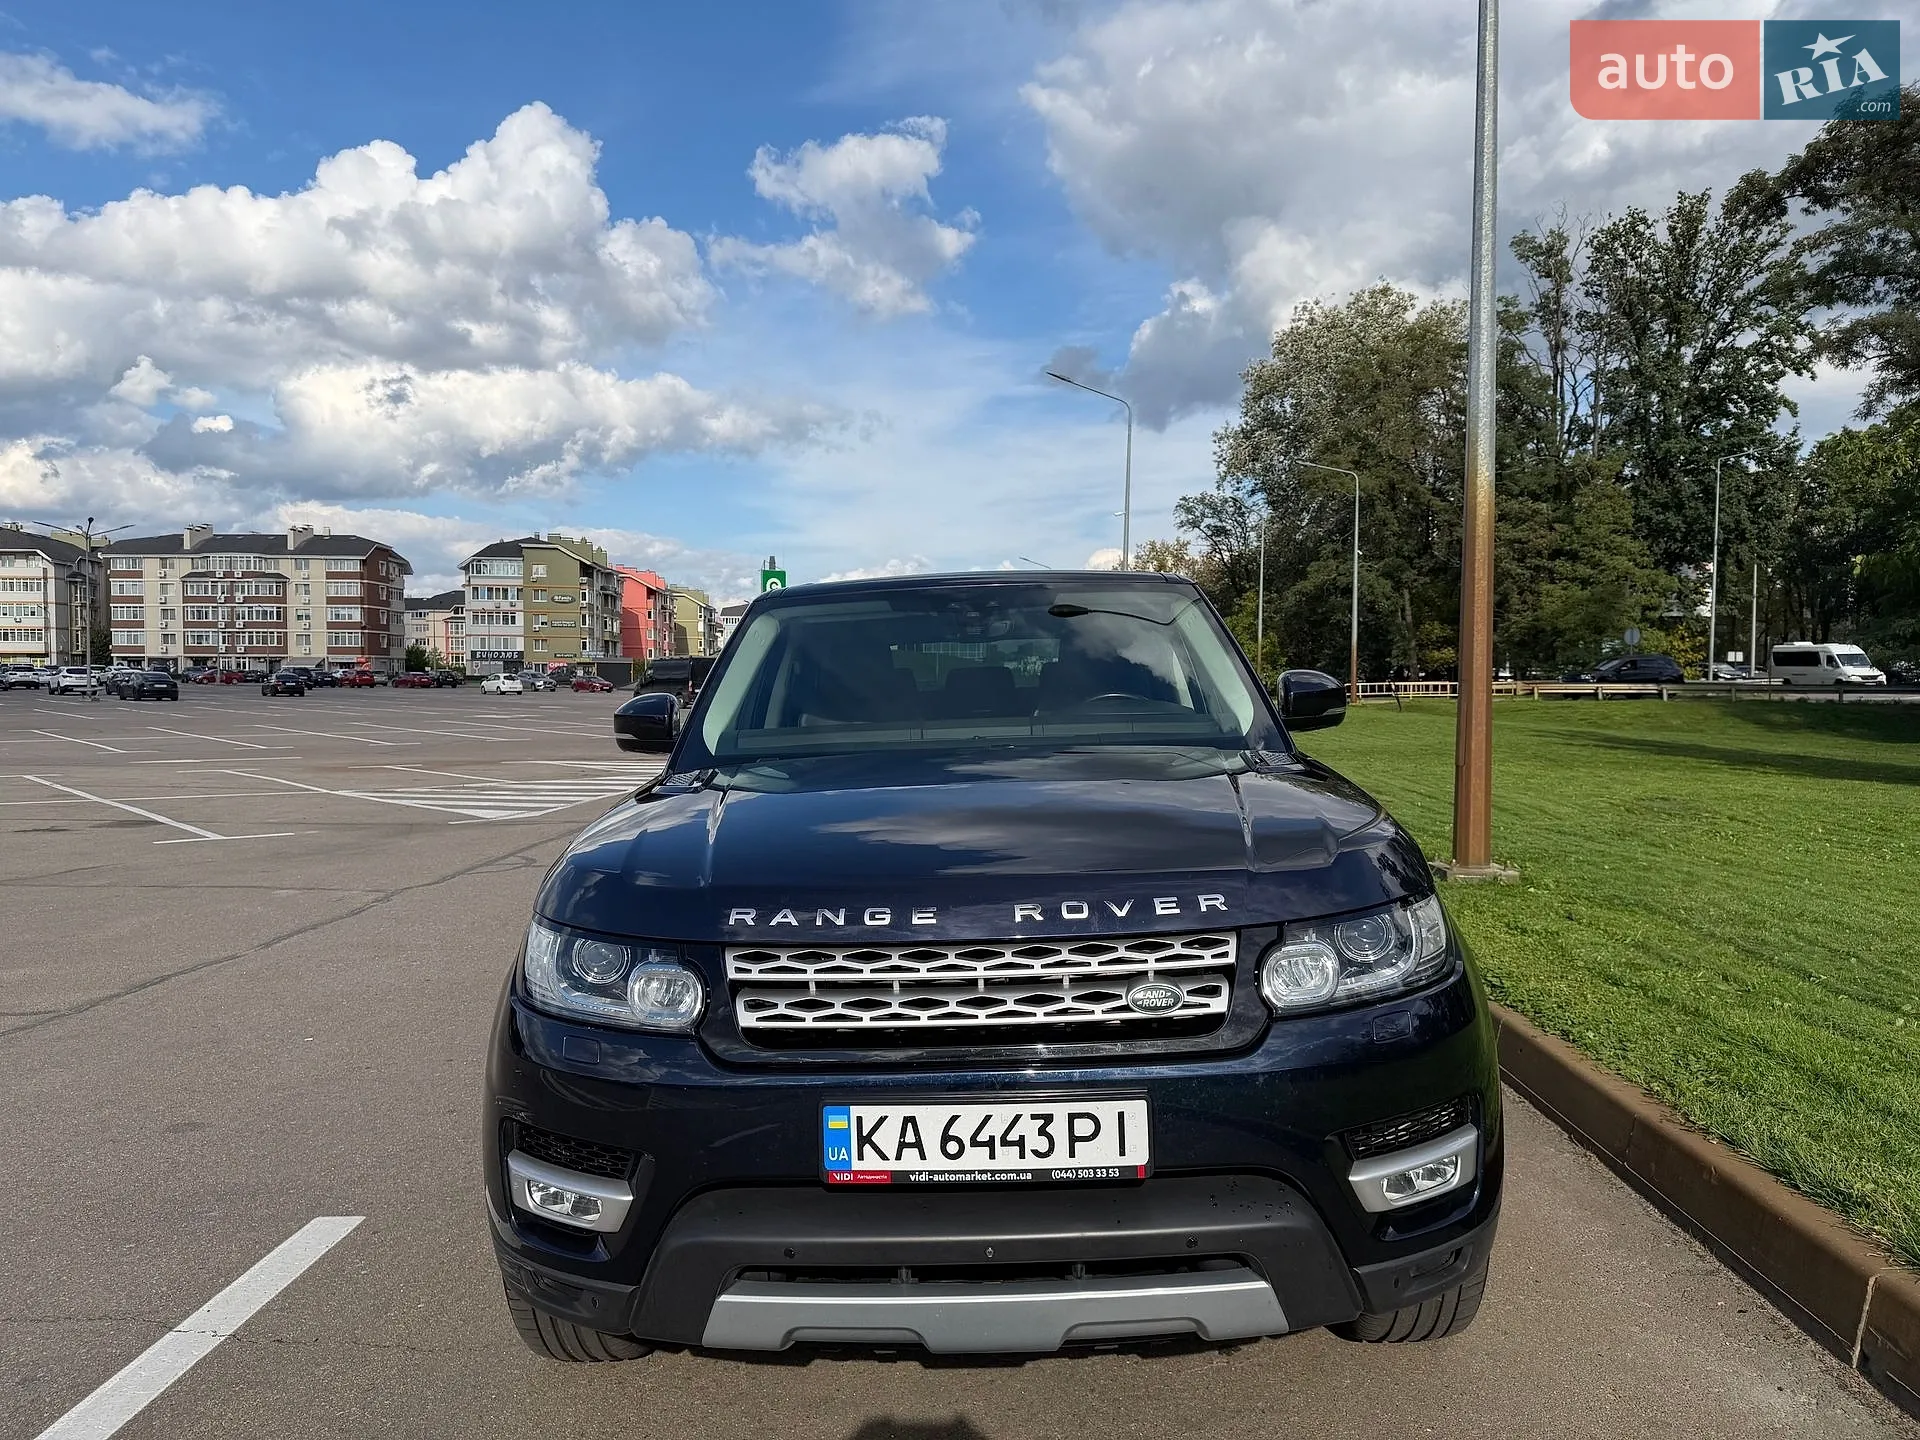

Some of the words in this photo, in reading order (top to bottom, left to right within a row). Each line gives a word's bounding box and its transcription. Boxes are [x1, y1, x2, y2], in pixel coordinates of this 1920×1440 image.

[727, 906, 938, 926] RANGE
[1014, 893, 1229, 923] ROVER
[1140, 989, 1166, 999] LAND
[1142, 998, 1174, 1008] ROVER
[828, 1146, 849, 1162] UA
[832, 1172, 854, 1181] VIDI
[909, 1171, 1033, 1182] vidi-automarket.com.ua
[1051, 1169, 1076, 1180] (044)
[1077, 1168, 1094, 1179] 503
[1095, 1168, 1108, 1178] 33
[1108, 1168, 1120, 1177] 53
